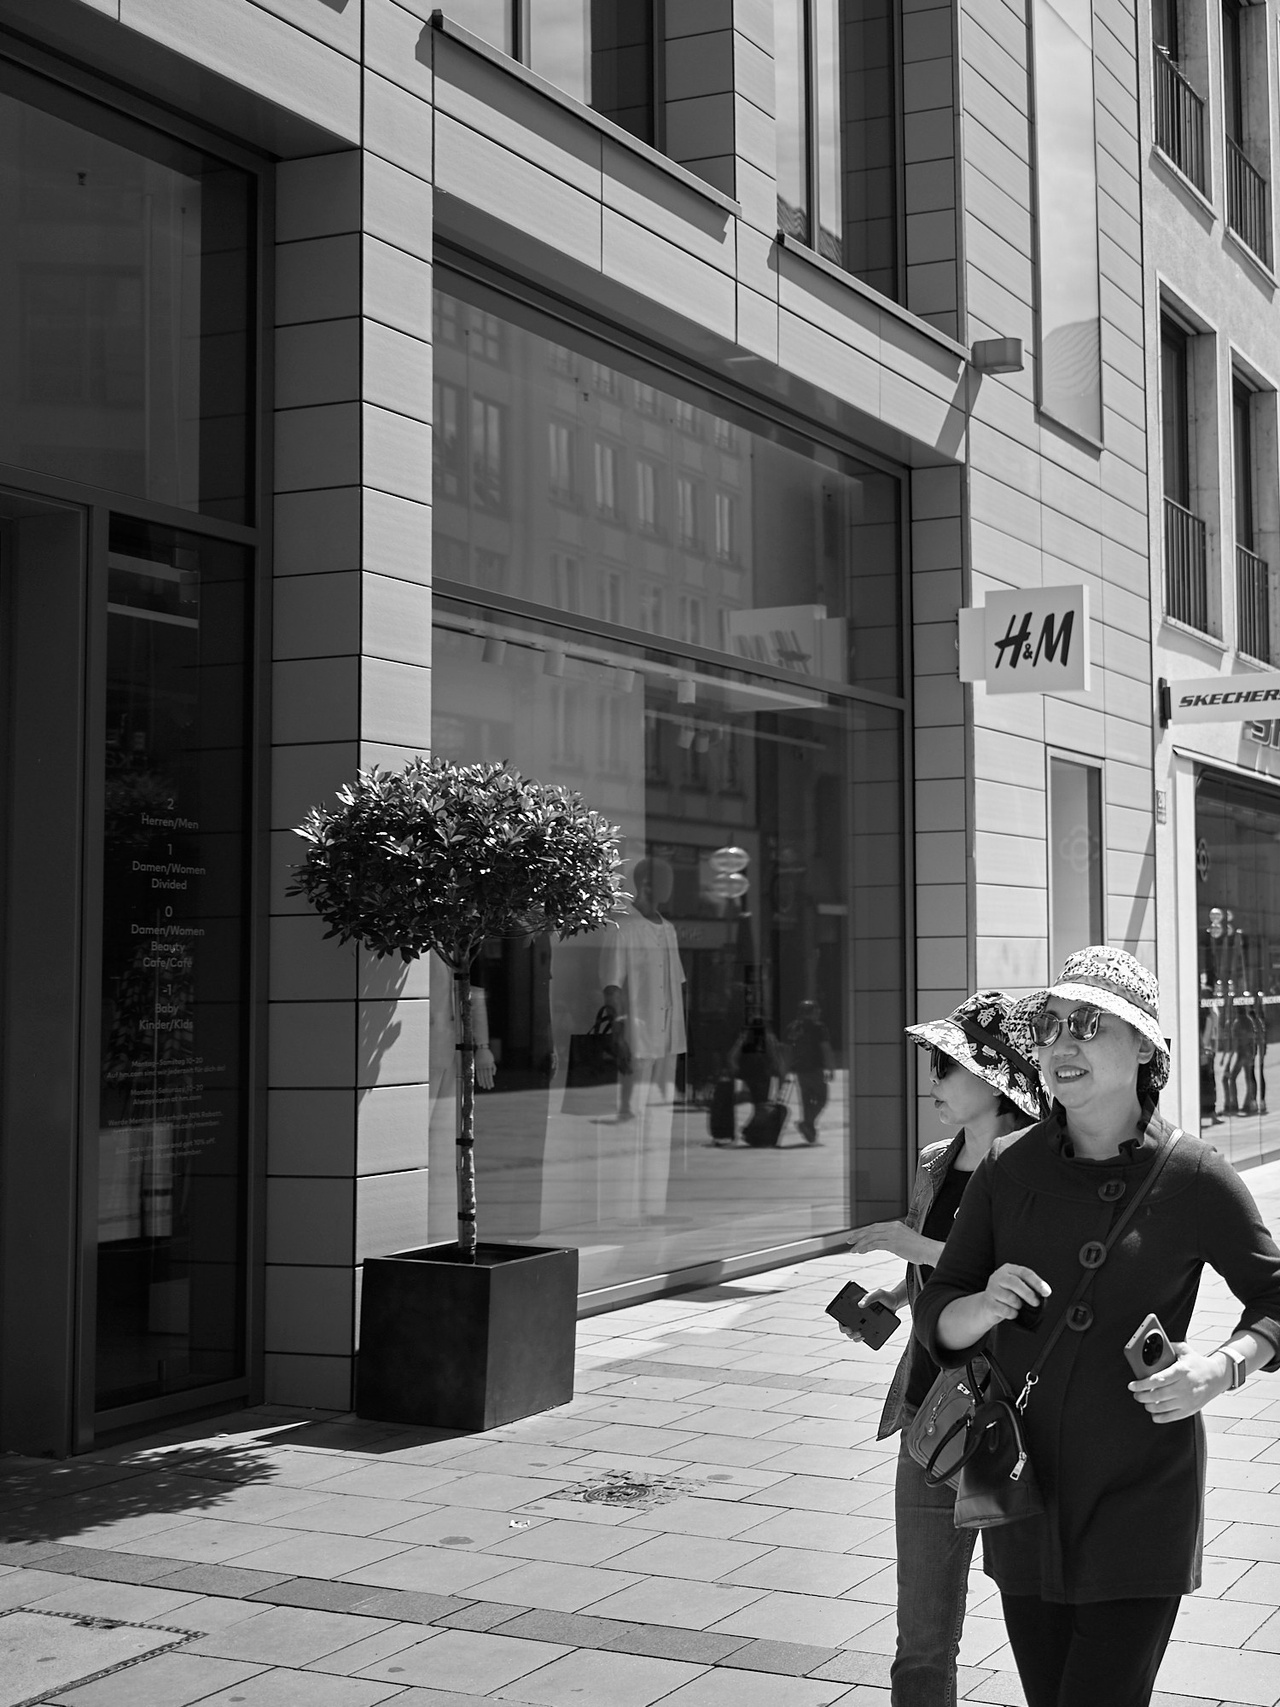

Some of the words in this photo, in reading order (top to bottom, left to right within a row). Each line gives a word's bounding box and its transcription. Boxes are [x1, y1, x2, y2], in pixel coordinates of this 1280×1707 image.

[994, 610, 1075, 669] H&M
[167, 798, 174, 810] 2
[141, 814, 199, 830] Herren/Men
[167, 843, 173, 855] 1
[132, 860, 206, 875] Damen/Women
[151, 878, 187, 890] Divided
[165, 905, 173, 917] 0
[131, 924, 205, 937] Damen/Women
[151, 941, 185, 954] Beauty
[162, 984, 172, 996] -1
[155, 1003, 179, 1016] Baby
[139, 1019, 193, 1032] Kinder/Kids
